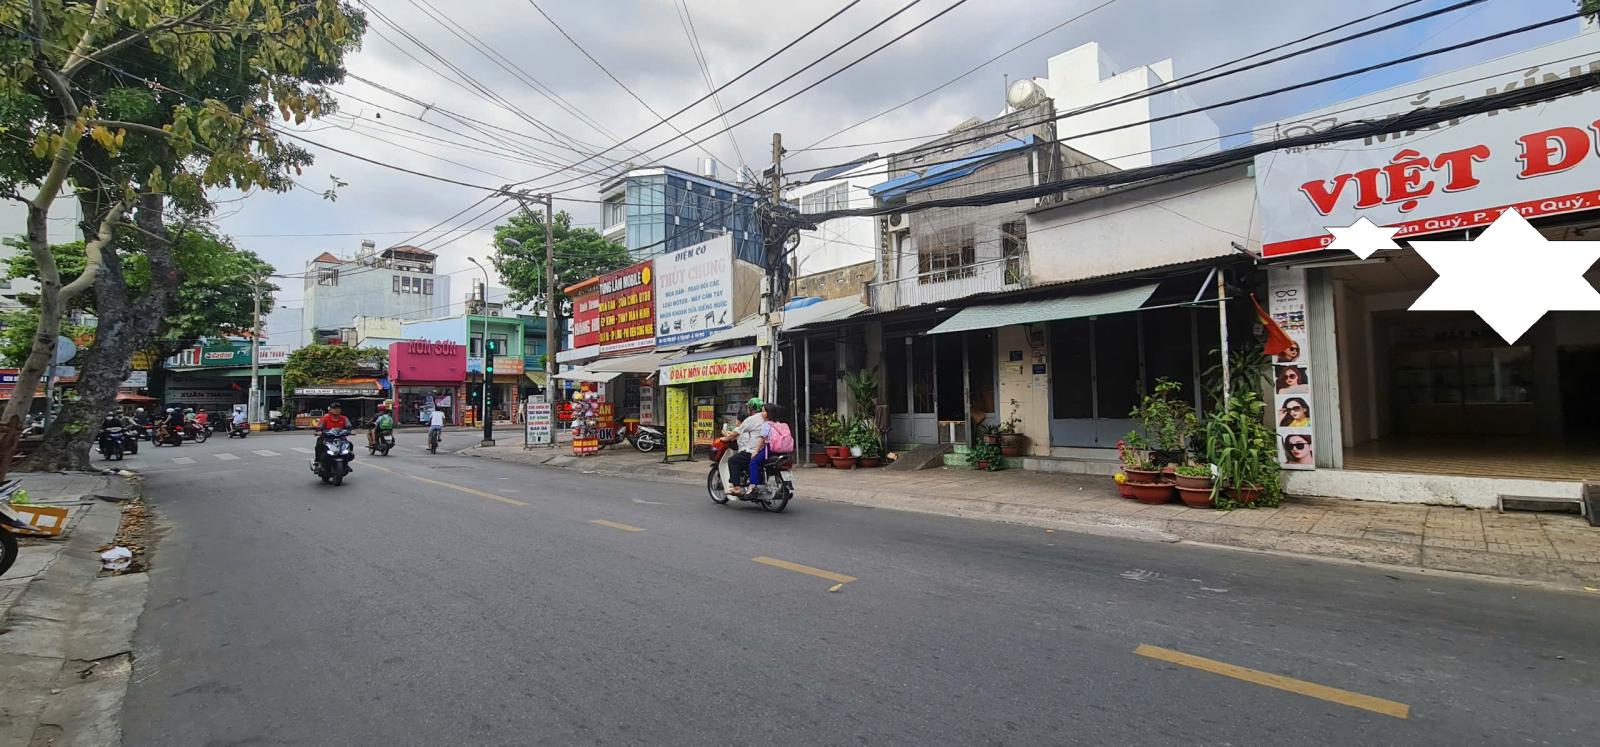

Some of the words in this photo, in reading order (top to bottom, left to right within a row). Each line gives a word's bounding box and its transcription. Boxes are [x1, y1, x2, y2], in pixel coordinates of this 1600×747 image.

[1299, 144, 1490, 216] VIỆT
[1516, 119, 1600, 180] Đ
[1398, 224, 1419, 234] ân
[1424, 216, 1466, 230] Quý,
[1474, 213, 1488, 222] P.
[1540, 196, 1590, 211] Quý,
[623, 272, 641, 288] MOBILE
[408, 336, 431, 355] NÓN
[434, 339, 457, 356] SƠN
